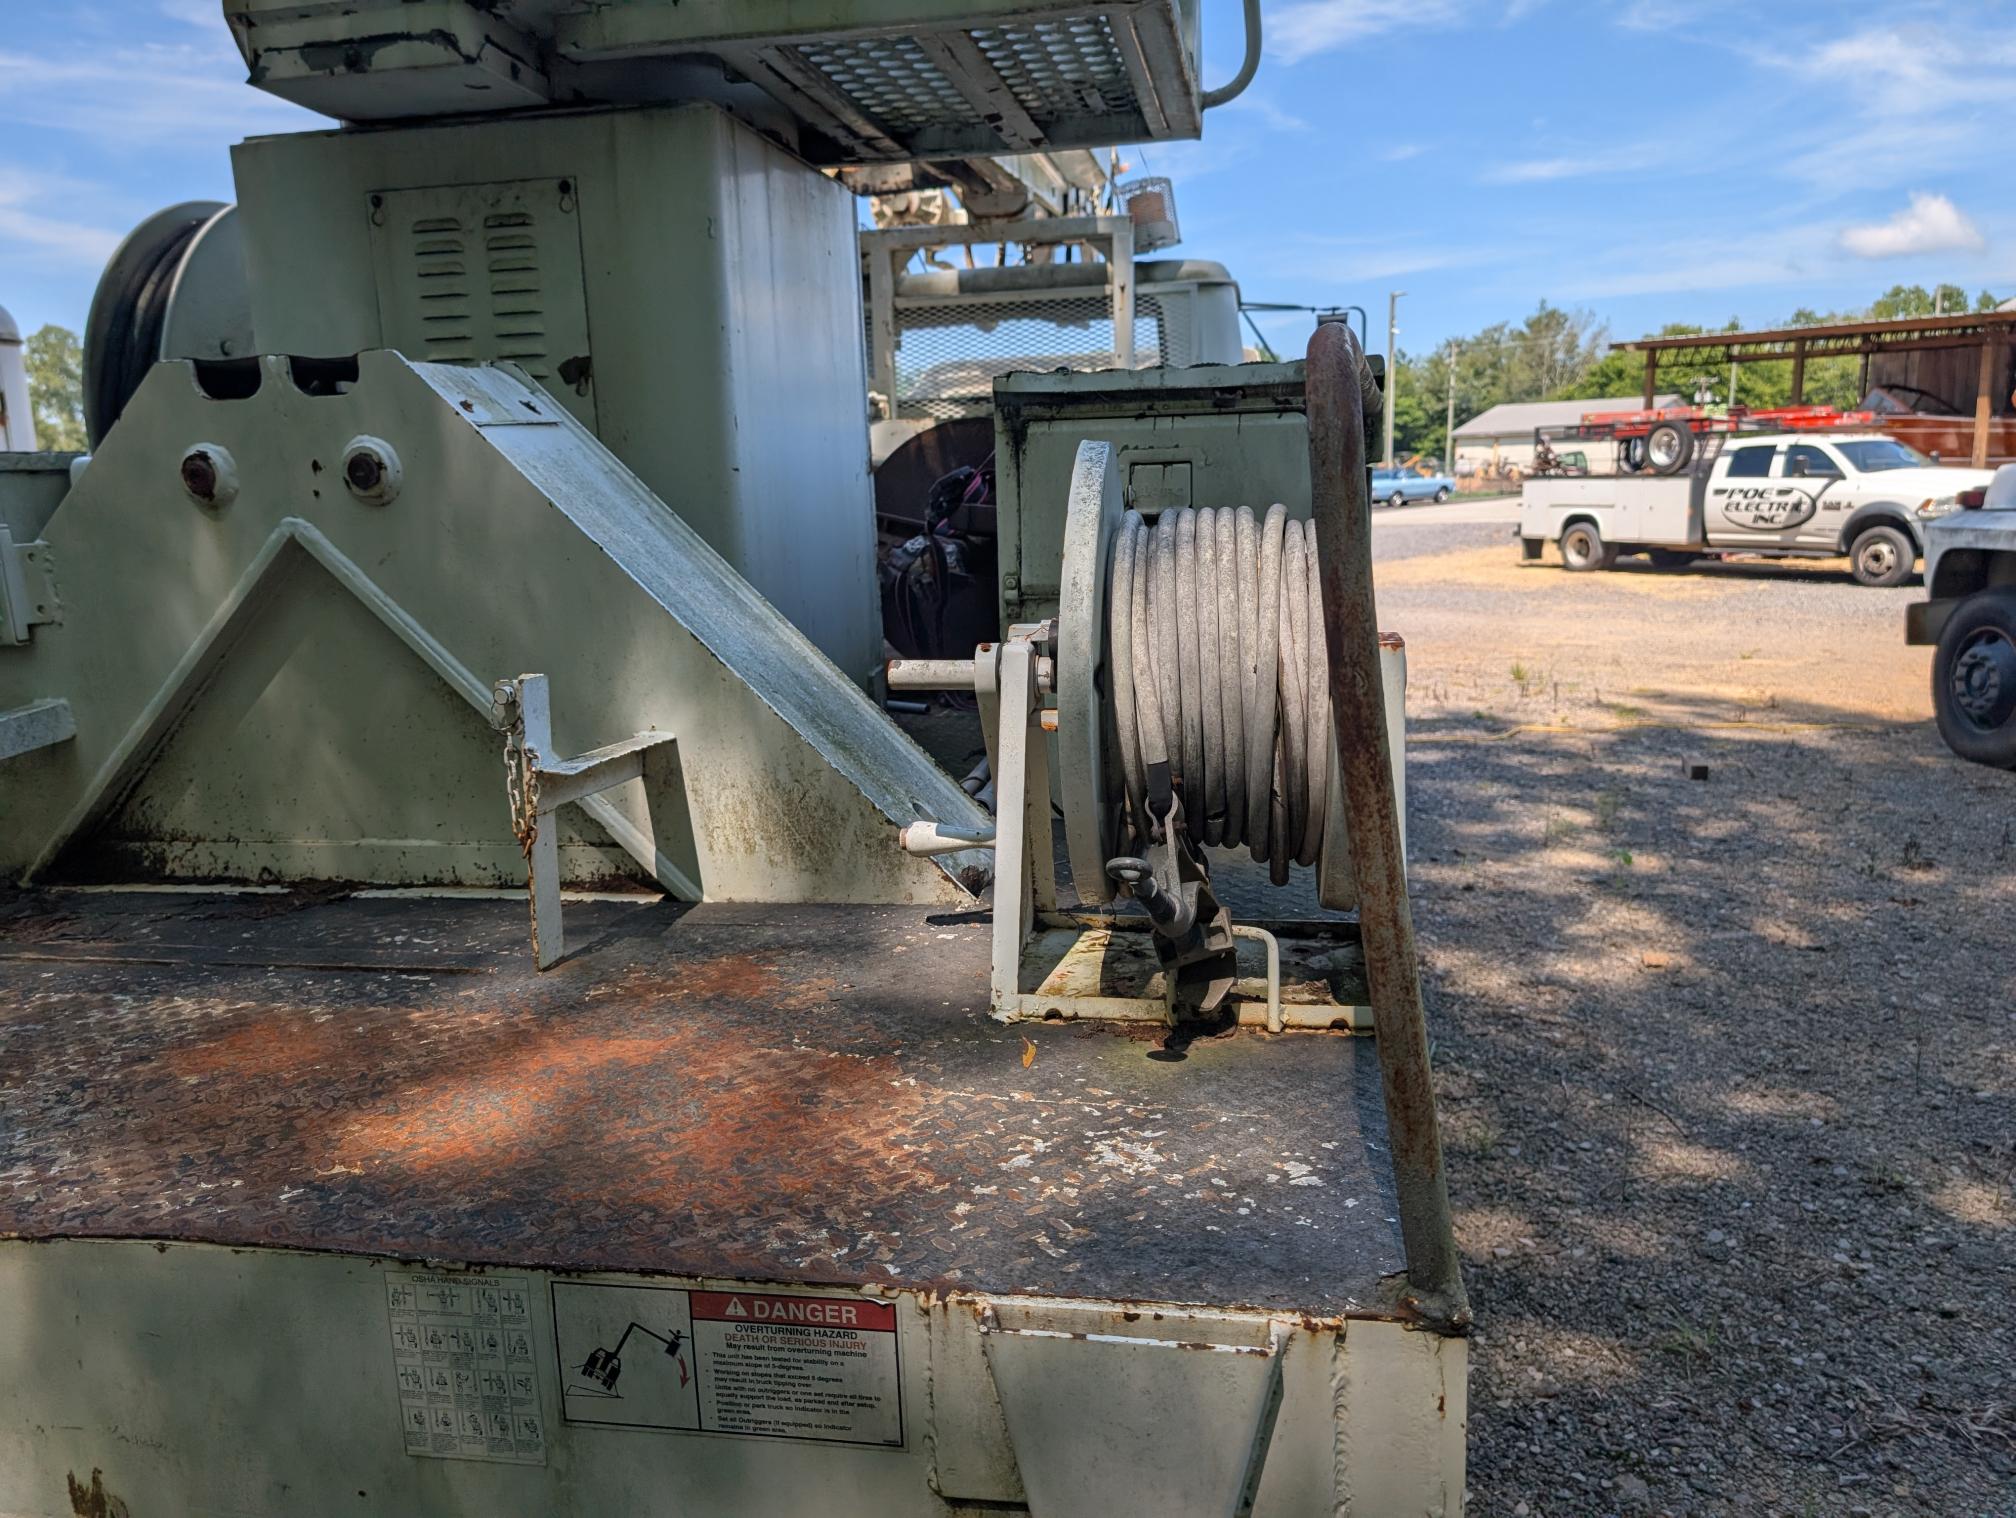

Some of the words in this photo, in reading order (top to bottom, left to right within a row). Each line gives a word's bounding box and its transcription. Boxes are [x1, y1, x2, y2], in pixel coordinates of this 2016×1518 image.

[1727, 488, 1774, 499] POE
[754, 1300, 858, 1324] DANGER
[735, 1324, 810, 1337] OVERTURNING
[814, 1330, 858, 1340] HAZARD
[725, 1333, 758, 1343] DEATH
[762, 1335, 777, 1344] OR
[780, 1336, 826, 1347] SERIOUS
[830, 1339, 866, 1350] INJURY
[726, 1343, 741, 1351] May
[787, 1347, 831, 1356] overturning
[803, 1358, 828, 1366] stability
